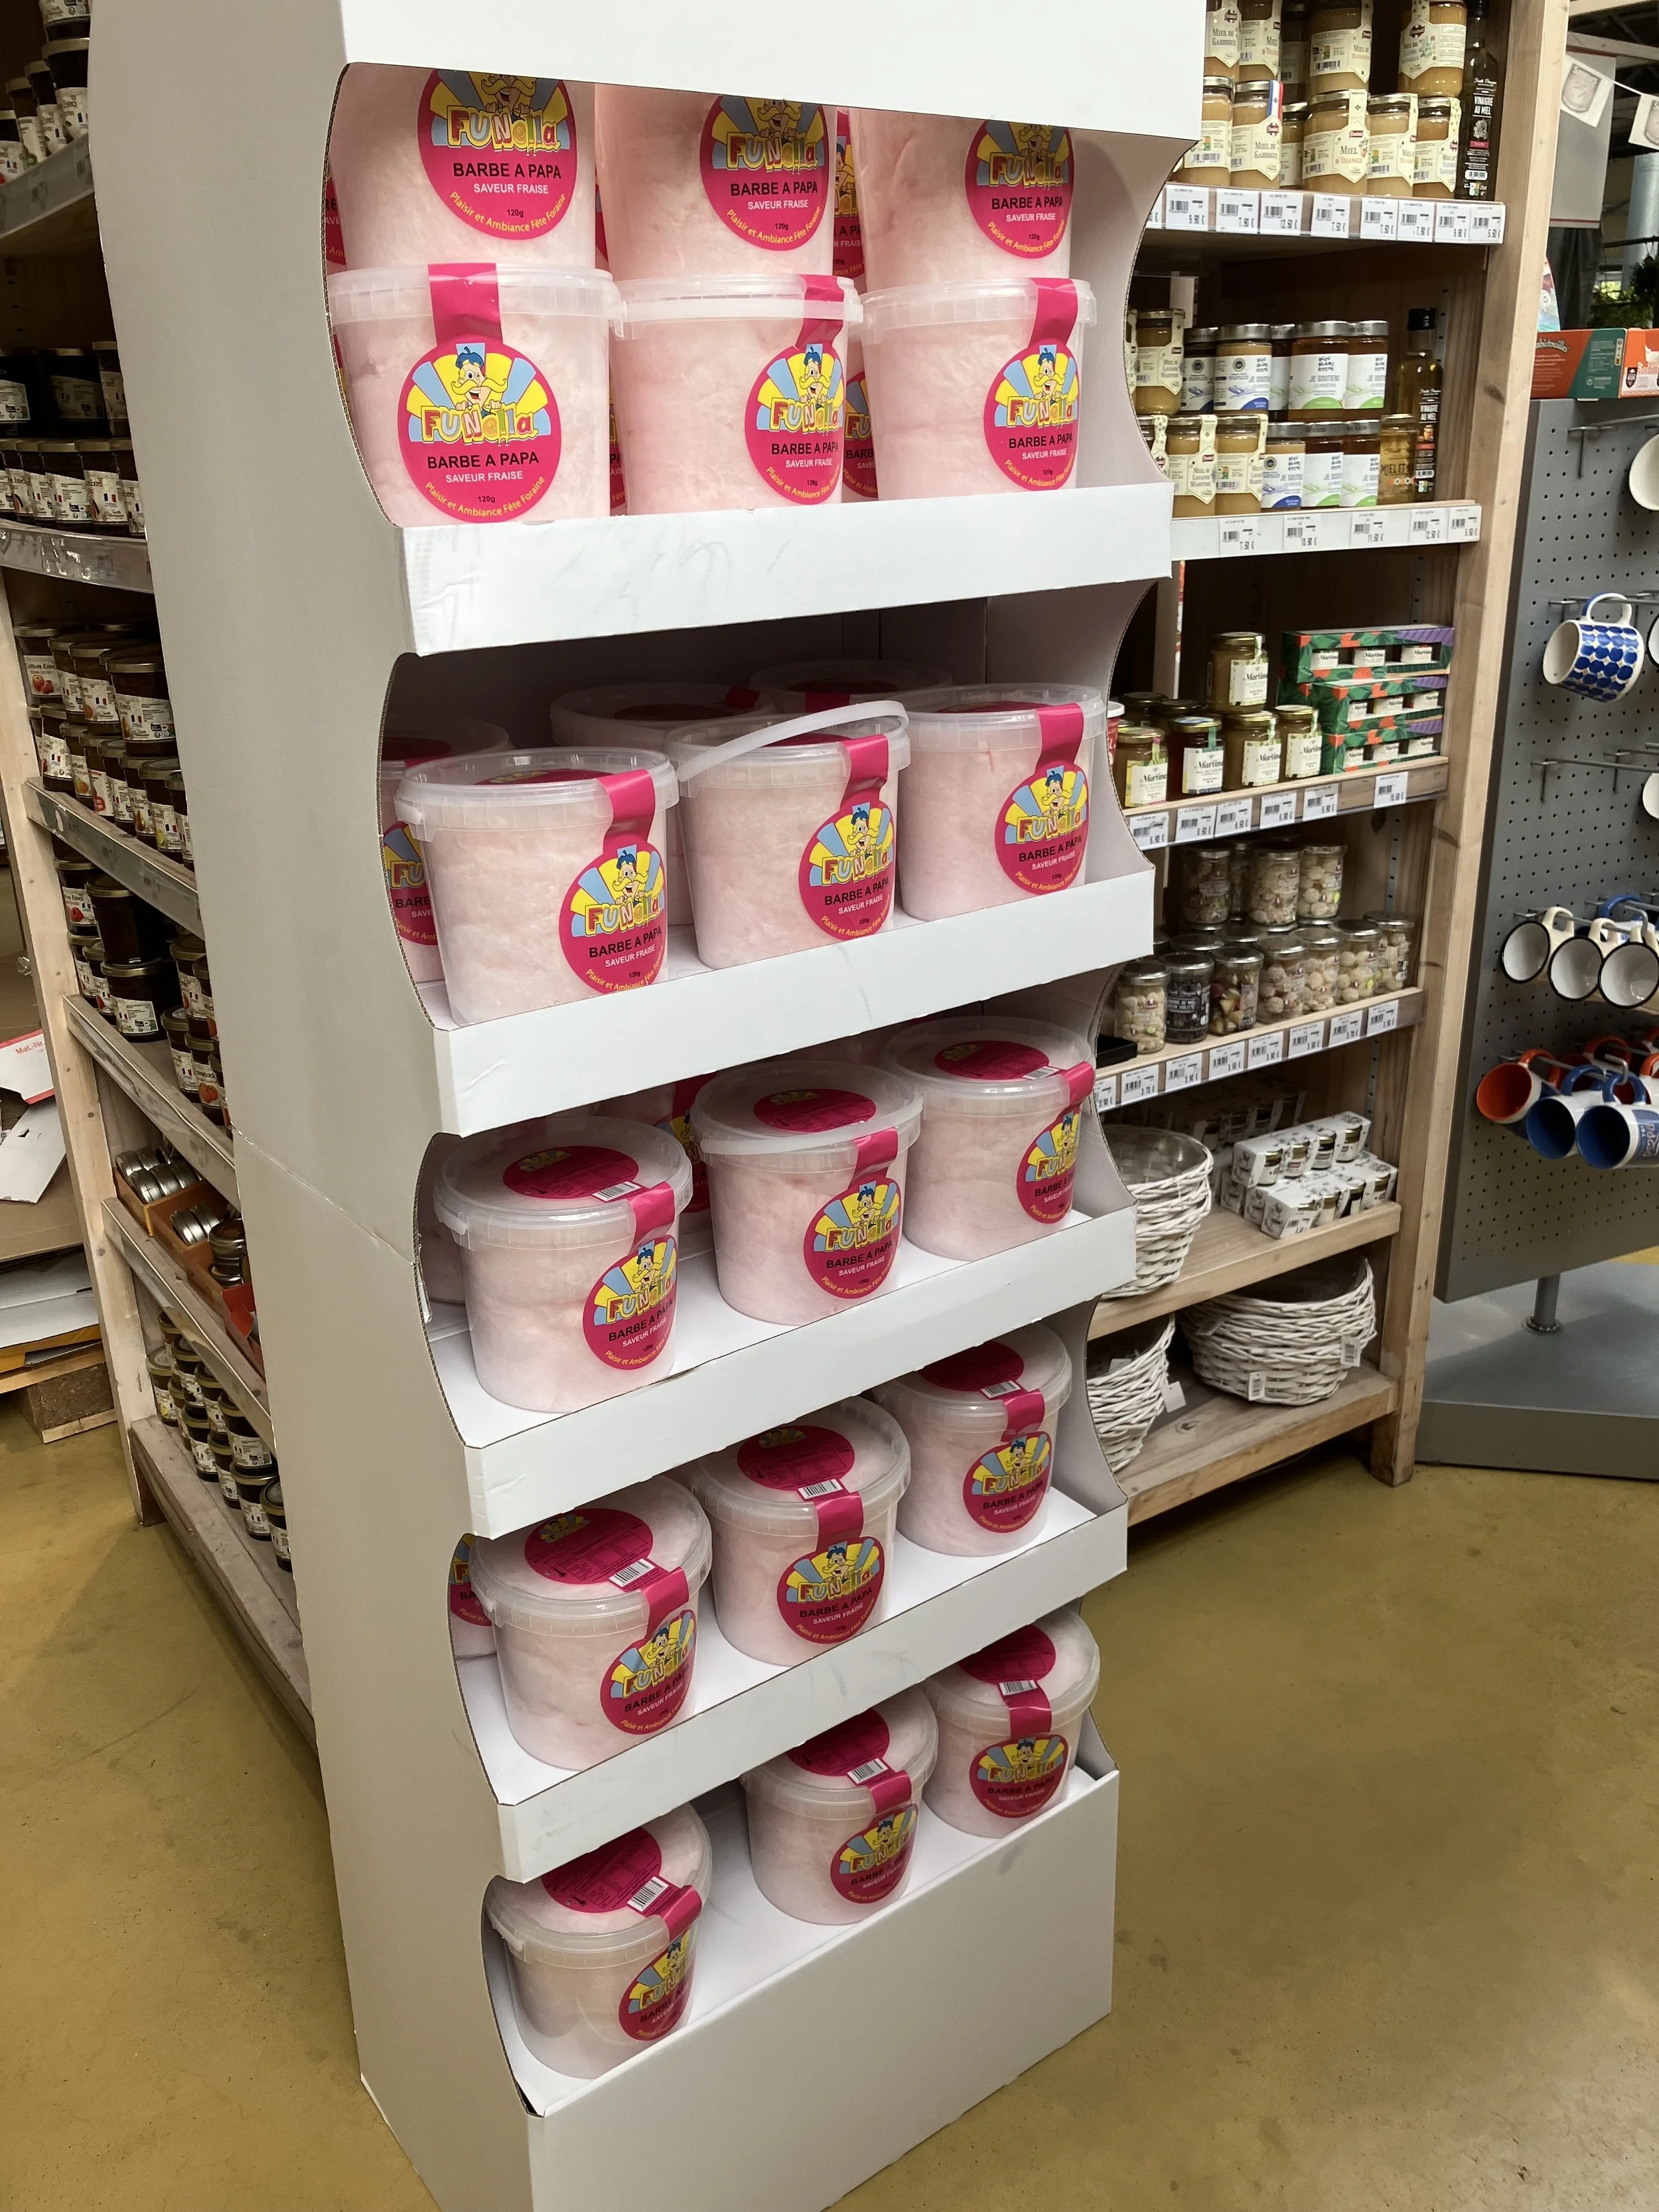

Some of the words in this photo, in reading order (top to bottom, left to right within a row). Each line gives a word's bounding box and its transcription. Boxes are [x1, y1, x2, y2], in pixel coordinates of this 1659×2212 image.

[1475, 96, 1493, 106] VINAIGRE
[1481, 106, 1491, 115] MIEL
[453, 163, 510, 178] BARBE
[515, 164, 525, 177] A
[529, 164, 562, 179] PAPA
[473, 183, 514, 194] SAVEUR
[517, 183, 548, 194] FRAISE
[731, 182, 778, 196] BARBE
[782, 183, 791, 194] A
[794, 181, 818, 194] PAPA
[449, 191, 474, 217] Plaisir
[474, 212, 484, 223] et
[484, 218, 530, 232] Ambiance
[530, 216, 547, 230] Fête
[545, 193, 566, 221] Foraine
[507, 208, 524, 218] 120g
[747, 200, 782, 210] SAVEUR
[784, 200, 809, 208] FRAISE
[991, 198, 1033, 210] BARBE
[1035, 199, 1043, 208] A
[1044, 196, 1063, 208] PAPA
[727, 209, 749, 232] Plaisir
[748, 228, 757, 237] et
[757, 232, 794, 244] Ambiance
[794, 230, 806, 243] Fête
[987, 222, 1006, 242] Plaisir
[1005, 238, 1013, 247] et
[1013, 241, 1043, 253] Ambiance
[421, 404, 538, 445] FUNella
[771, 443, 812, 455] BARBE
[814, 443, 821, 454] A
[822, 441, 839, 453] PAPA
[1009, 436, 1047, 449] BARBE
[1049, 435, 1055, 445] A
[1057, 433, 1072, 444] PAPA
[427, 454, 481, 469] BARBE
[485, 455, 496, 467] A
[500, 451, 539, 466] PAPA
[785, 459, 814, 468] SAVEUR
[815, 458, 833, 467] FRAISE
[1022, 451, 1048, 460] SAVEUR
[1049, 449, 1067, 457] FRAISE
[445, 473, 486, 483] SAVEUR
[488, 471, 523, 480] FRAISE
[766, 467, 784, 487] Plaisir
[791, 488, 820, 499] Ambiance
[1005, 459, 1021, 478] Plaisir
[1029, 477, 1056, 487] Ambiance
[425, 482, 447, 505] Plaisir
[447, 500, 457, 510] et
[457, 504, 502, 517] Ambiance
[503, 500, 522, 512] Fête
[520, 476, 545, 504] Foraine
[1019, 846, 1055, 862] BARBE
[1058, 842, 1064, 852] A
[1065, 835, 1082, 851] PAPA
[1032, 857, 1057, 870] SAVEUR
[1058, 851, 1076, 864] FRAISE
[825, 889, 862, 905] BARBE
[865, 887, 871, 897] A
[873, 877, 889, 893] PAPA
[839, 903, 865, 914] SAVEUR
[865, 893, 883, 907] FRAISE
[821, 916, 839, 932] Plaisir
[845, 926, 872, 936] Ambiance
[589, 940, 632, 958] BARBE
[634, 936, 641, 948] A
[643, 926, 662, 943] PAPA
[605, 954, 635, 968] SAVEUR
[636, 944, 656, 959] FRAISE
[586, 969, 605, 986] Plaisir
[826, 1255, 864, 1269] BARBE
[866, 1252, 872, 1260] A
[875, 1240, 893, 1257] PAPA
[839, 1265, 865, 1276] SAVEUR
[867, 1256, 885, 1270] FRAISE
[609, 1319, 646, 1342] BARBE
[649, 1314, 655, 1326] A
[622, 1330, 648, 1347] SAVEUR
[983, 1496, 1017, 1509] BARBE
[994, 1504, 1018, 1514] SAVEUR
[800, 1603, 839, 1618] BARBE
[850, 1587, 873, 1605] PAPA
[813, 1614, 841, 1624] SAVEUR
[843, 1602, 863, 1618] FRAISE
[625, 1689, 663, 1712] BARBE
[638, 1698, 664, 1716] SAVEUR
[665, 1683, 684, 1702] FRAISE
